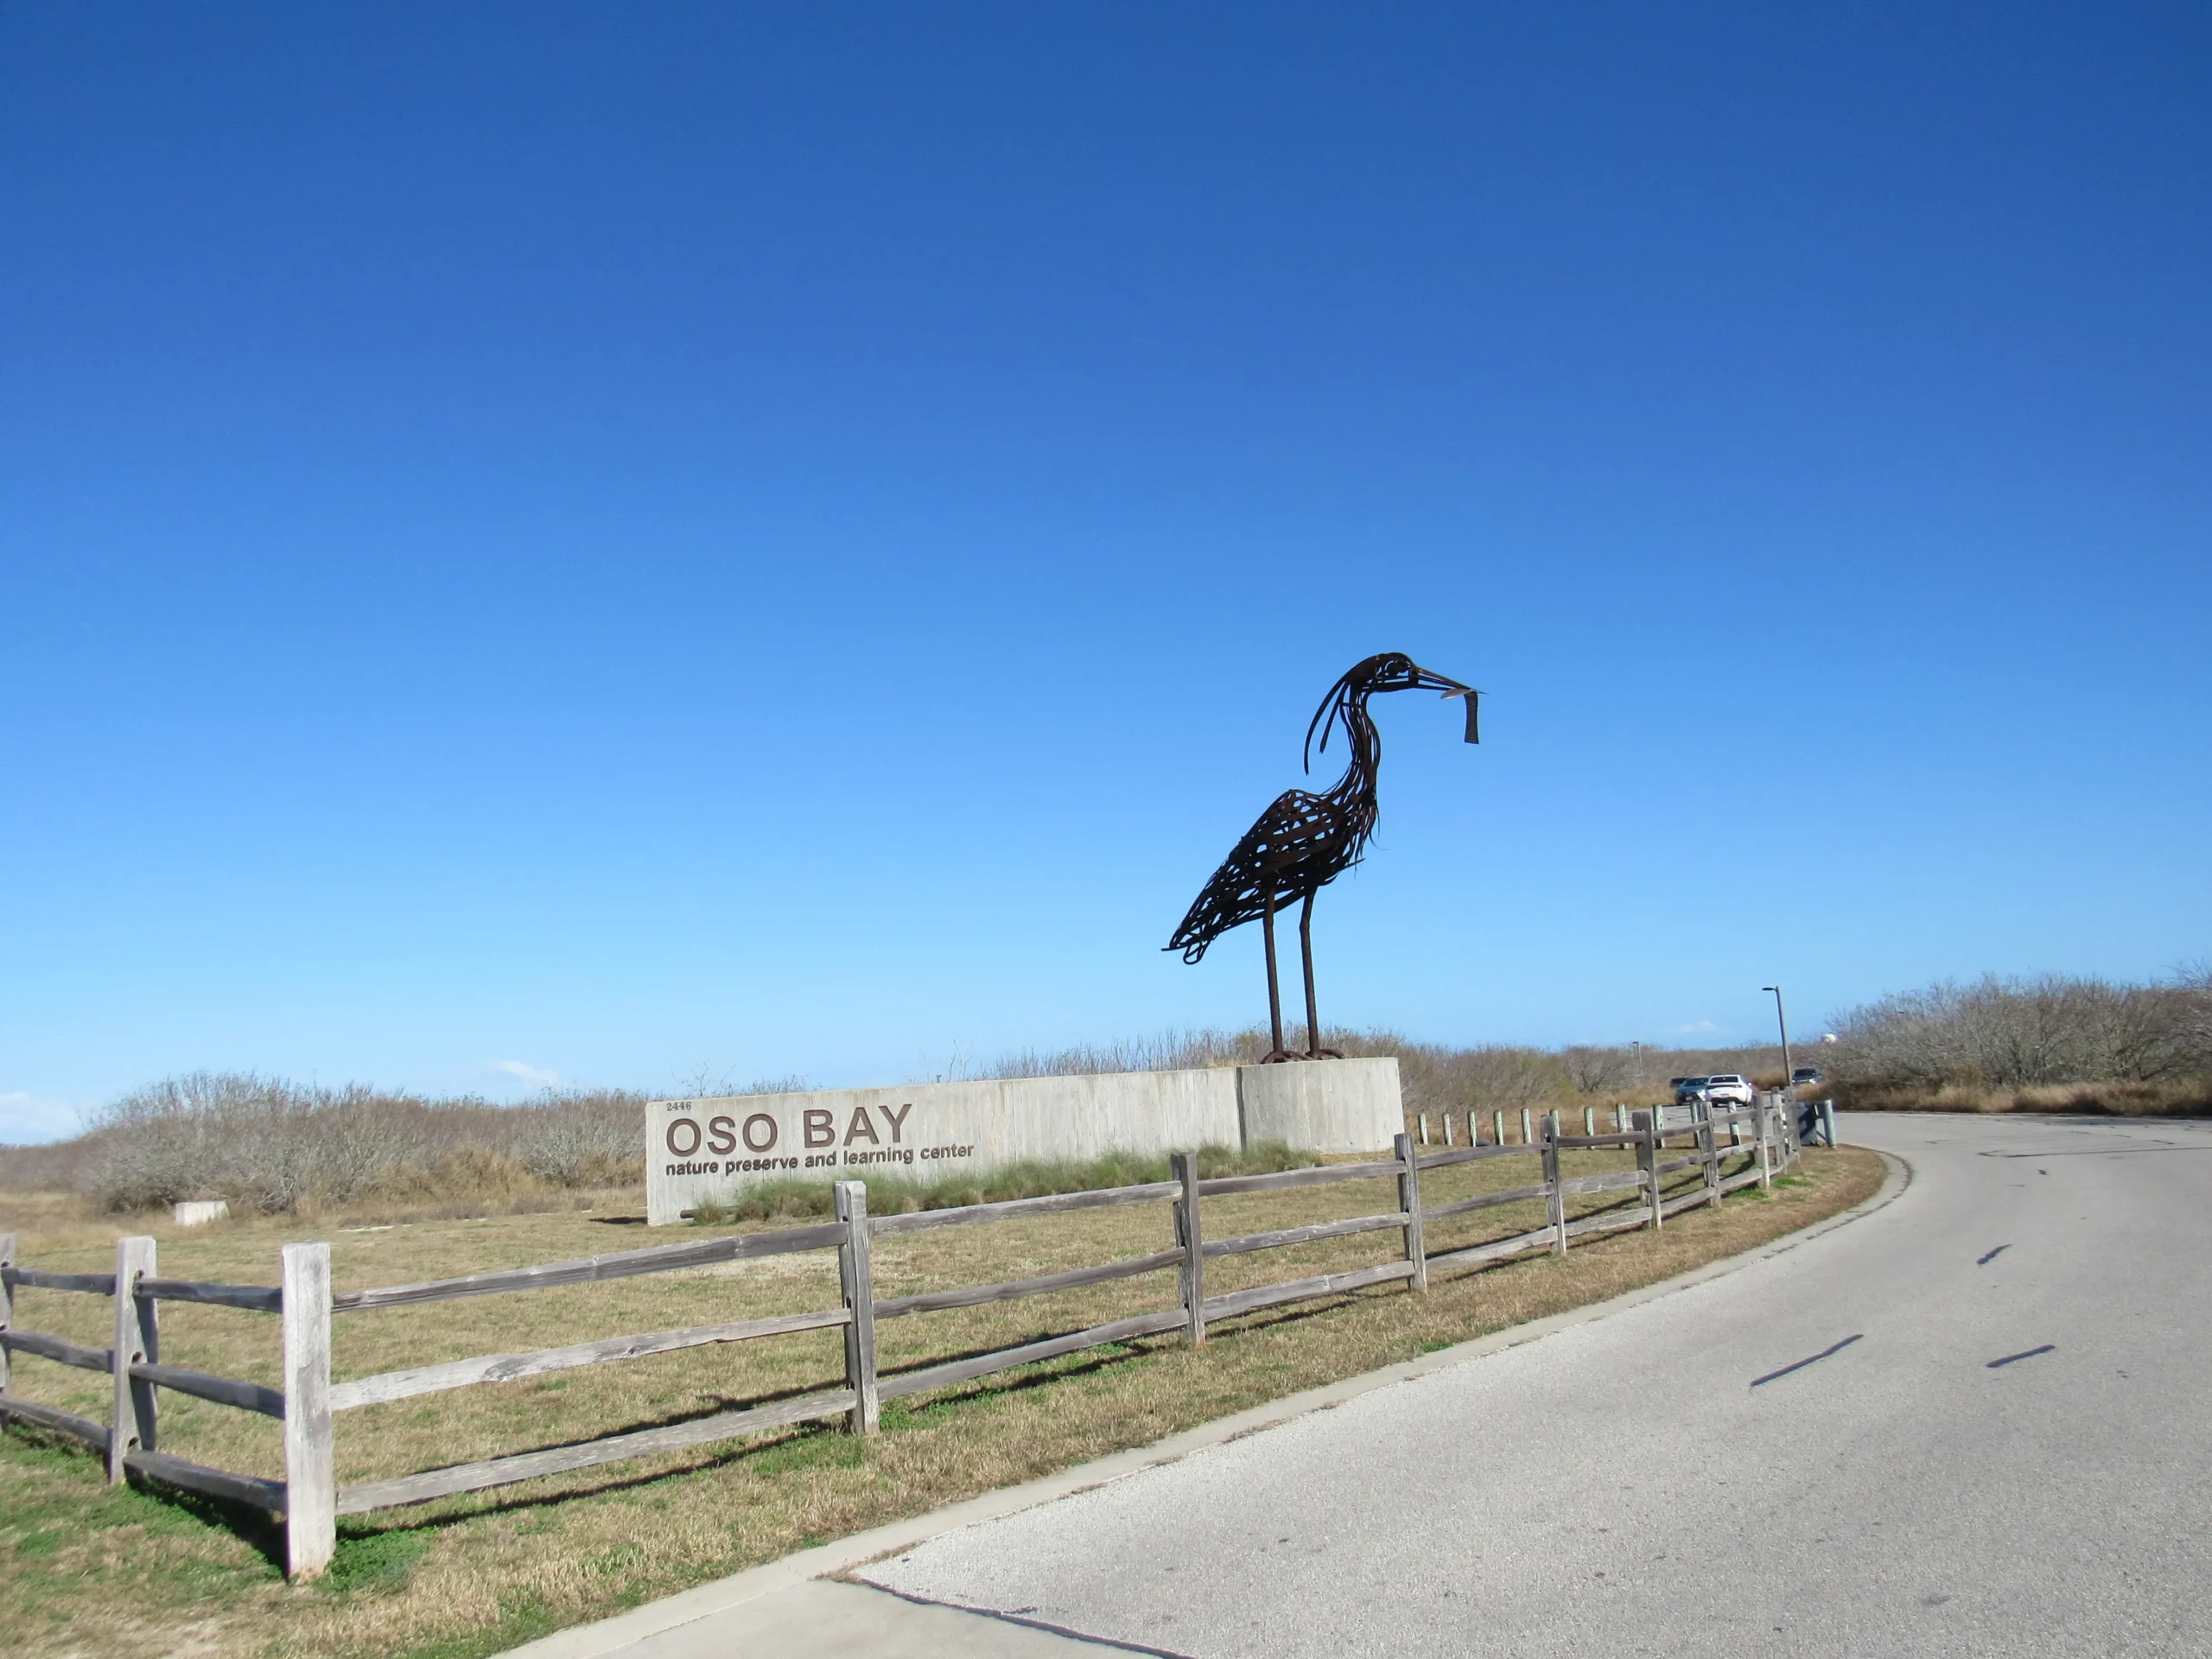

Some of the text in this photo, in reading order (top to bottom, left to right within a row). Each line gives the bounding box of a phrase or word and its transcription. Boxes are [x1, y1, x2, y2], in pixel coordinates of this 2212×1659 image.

[667, 1102, 691, 1111] 2446
[666, 1103, 912, 1157] OSO BAY
[666, 1143, 975, 1176] nature preserve and learning center
